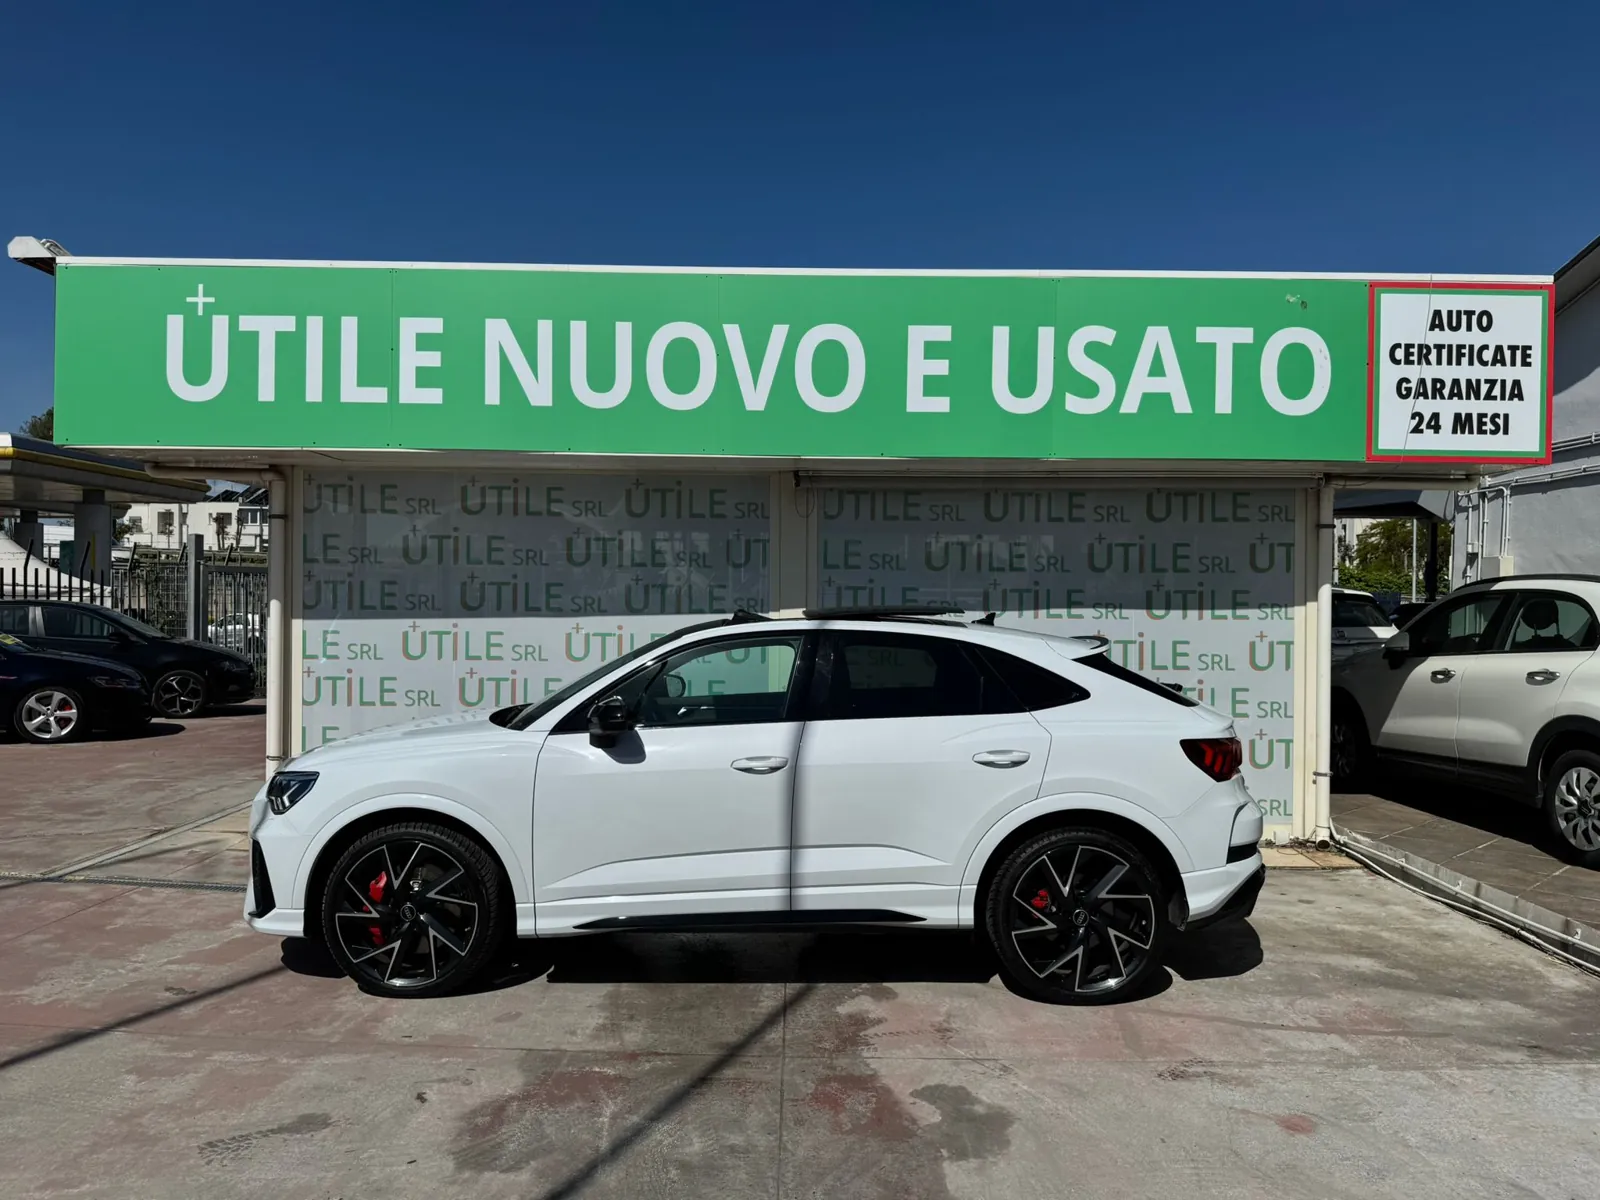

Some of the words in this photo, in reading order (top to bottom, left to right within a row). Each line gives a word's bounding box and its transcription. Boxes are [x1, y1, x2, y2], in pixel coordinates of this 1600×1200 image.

[1428, 309, 1493, 333] AUTO
[1389, 342, 1532, 367] CERTIFICATE
[484, 318, 866, 413] NUOVO
[906, 325, 952, 413] E
[991, 325, 1331, 416] USATO
[1396, 377, 1524, 401] GARANZIA
[1409, 411, 1442, 435] 24
[1451, 412, 1510, 436] MESI
[405, 498, 442, 515] SRL
[571, 500, 608, 517] SRL
[734, 502, 770, 519] SRL
[928, 504, 966, 522] SRL
[1093, 505, 1131, 523] SRL
[1257, 505, 1295, 522] SRL
[348, 547, 384, 565] SRL
[512, 549, 549, 566] SRL
[675, 551, 713, 569] SRL
[869, 553, 906, 571] SRL
[1033, 556, 1071, 573] SRL
[1198, 556, 1236, 574] SRL
[405, 594, 442, 611] SRL
[570, 596, 608, 613] SRL
[1092, 603, 1129, 620] SRL
[1257, 602, 1294, 620] SRL
[347, 643, 384, 660] SRL
[511, 644, 549, 662] SRL
[1197, 653, 1236, 671] SRL
[404, 690, 441, 707] SRL
[1257, 701, 1294, 718] SRL
[1257, 799, 1293, 816] SRL
